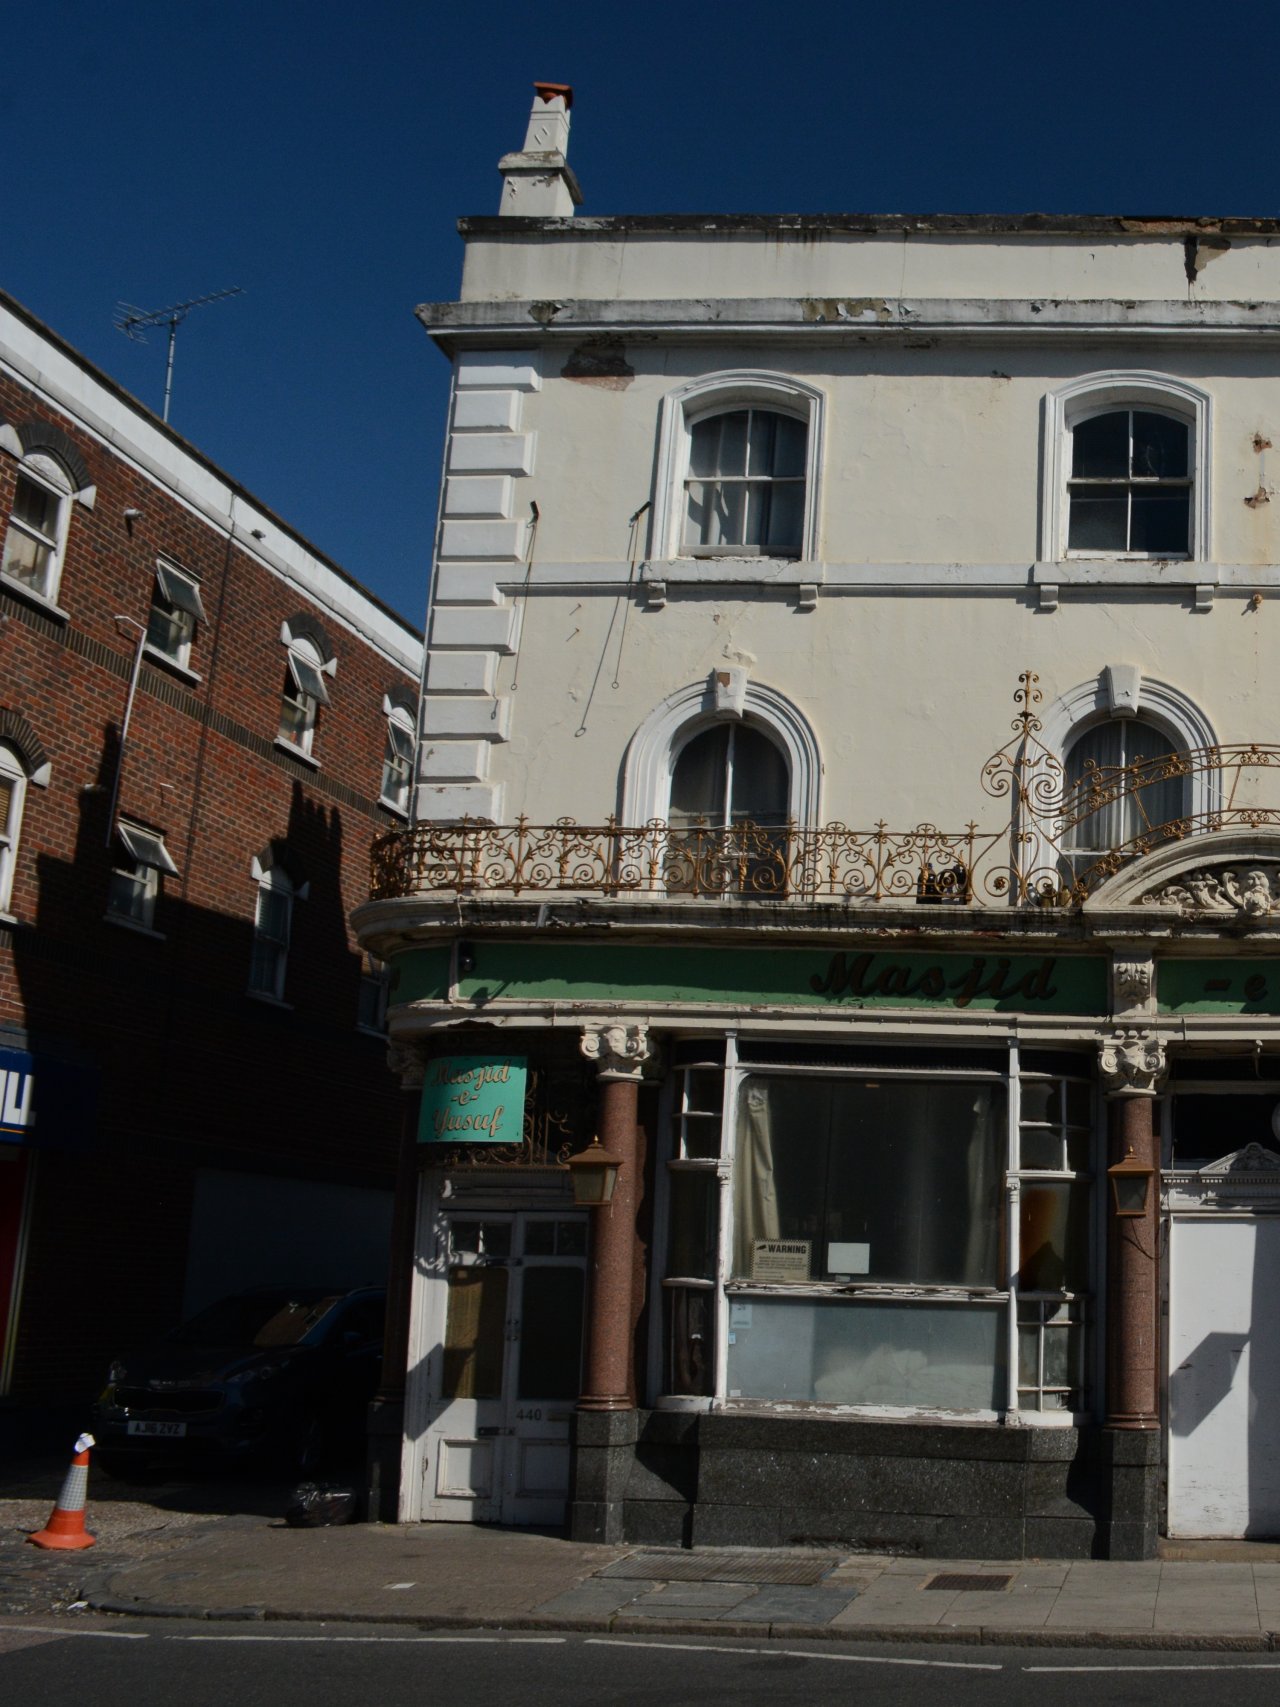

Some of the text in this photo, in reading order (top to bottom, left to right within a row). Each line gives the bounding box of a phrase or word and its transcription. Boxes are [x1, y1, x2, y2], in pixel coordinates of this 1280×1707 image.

[810, 951, 1058, 1008] Masjid
[432, 1060, 511, 1090] Masjid
[432, 1105, 504, 1137] Yusuf
[768, 1244, 807, 1254] WARNING
[516, 1408, 542, 1421] 440
